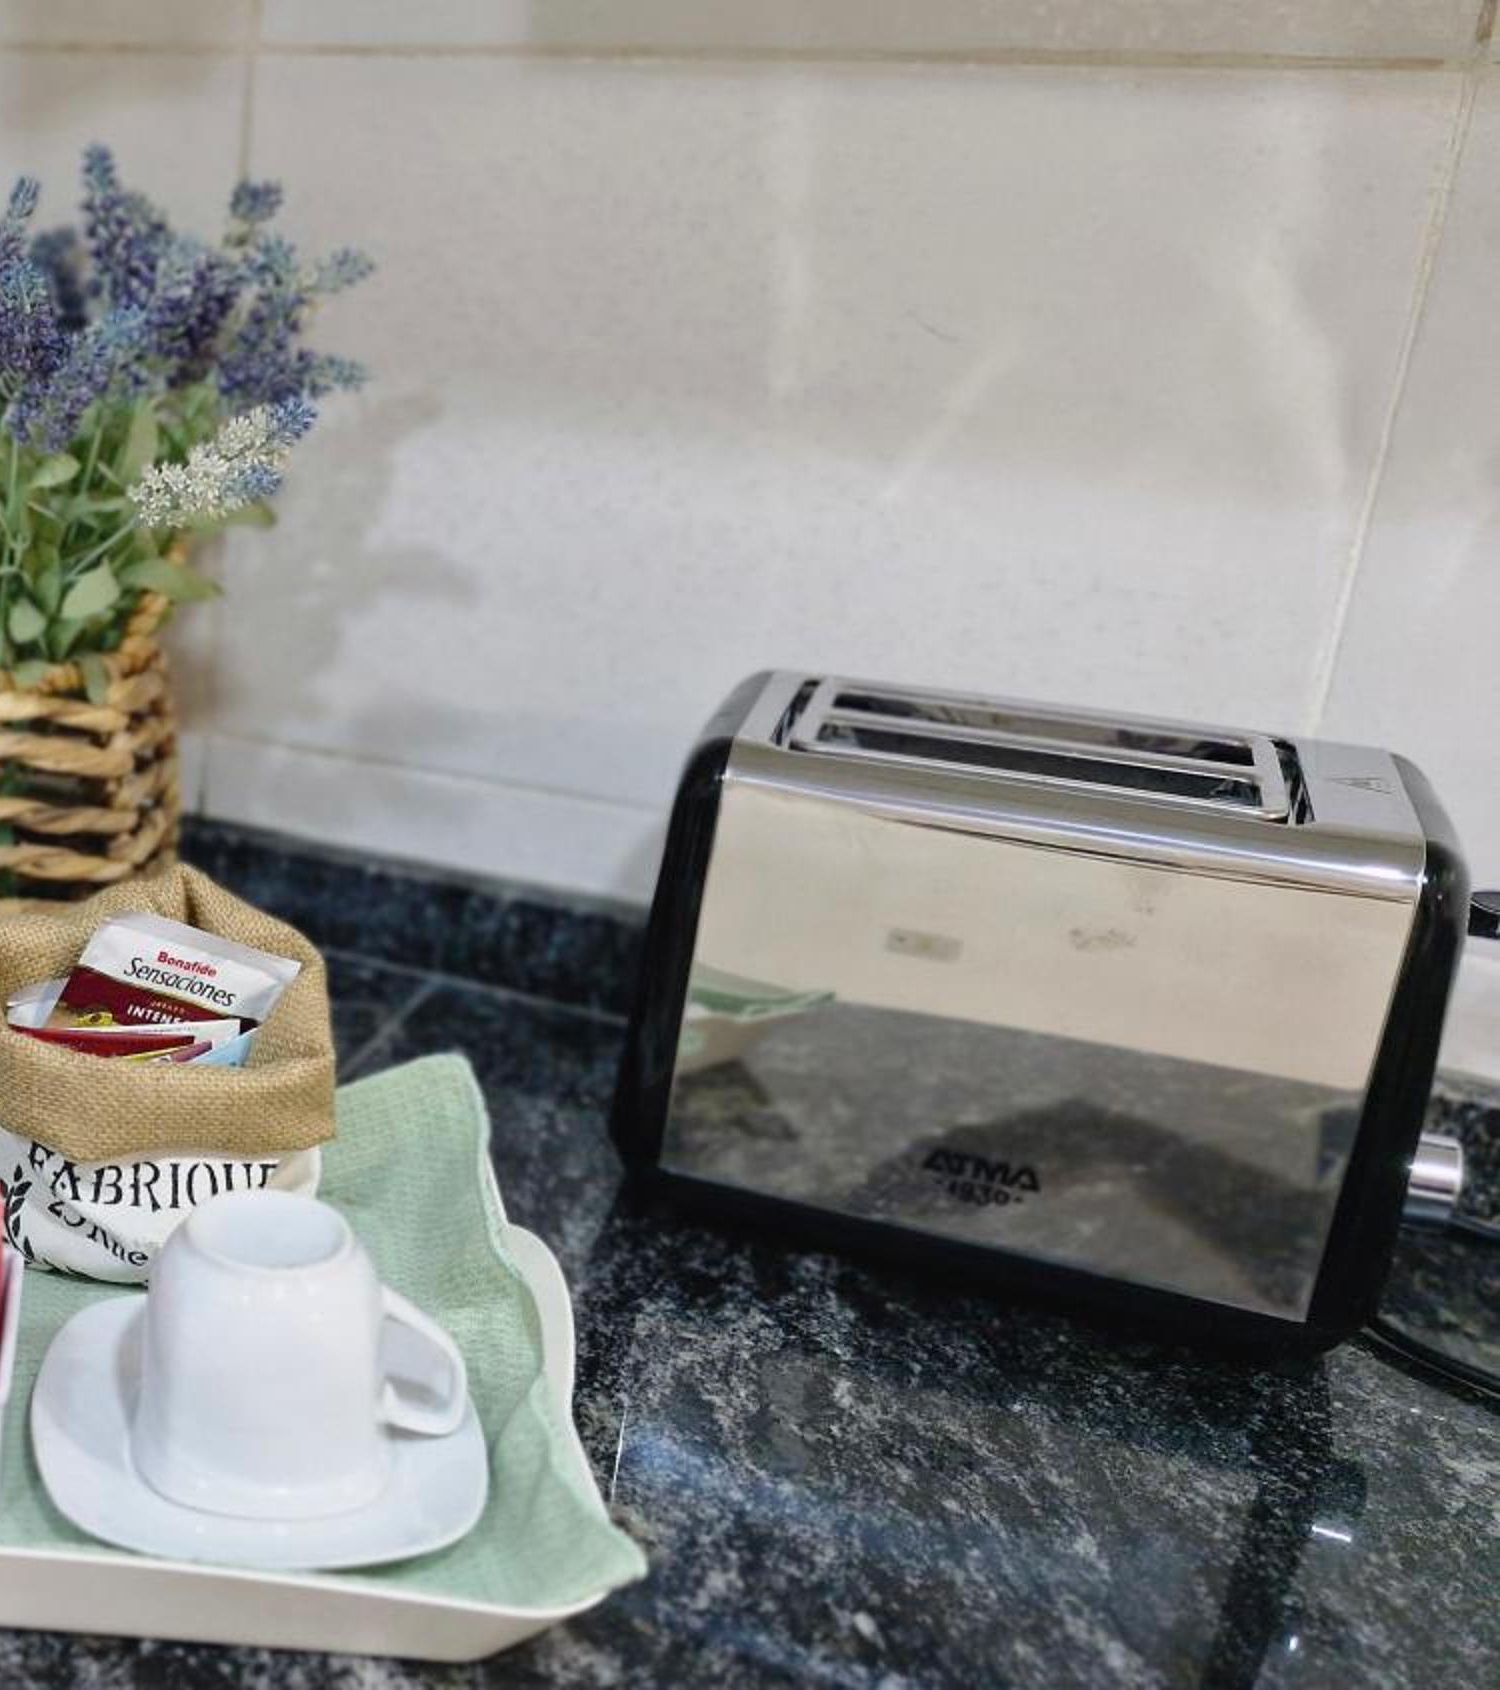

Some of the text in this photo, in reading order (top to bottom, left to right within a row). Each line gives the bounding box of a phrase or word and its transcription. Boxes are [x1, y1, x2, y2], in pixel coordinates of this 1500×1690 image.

[123, 957, 237, 1007] Sensaciones
[157, 951, 218, 977] Bonafide
[923, 1148, 1040, 1193] ATMA
